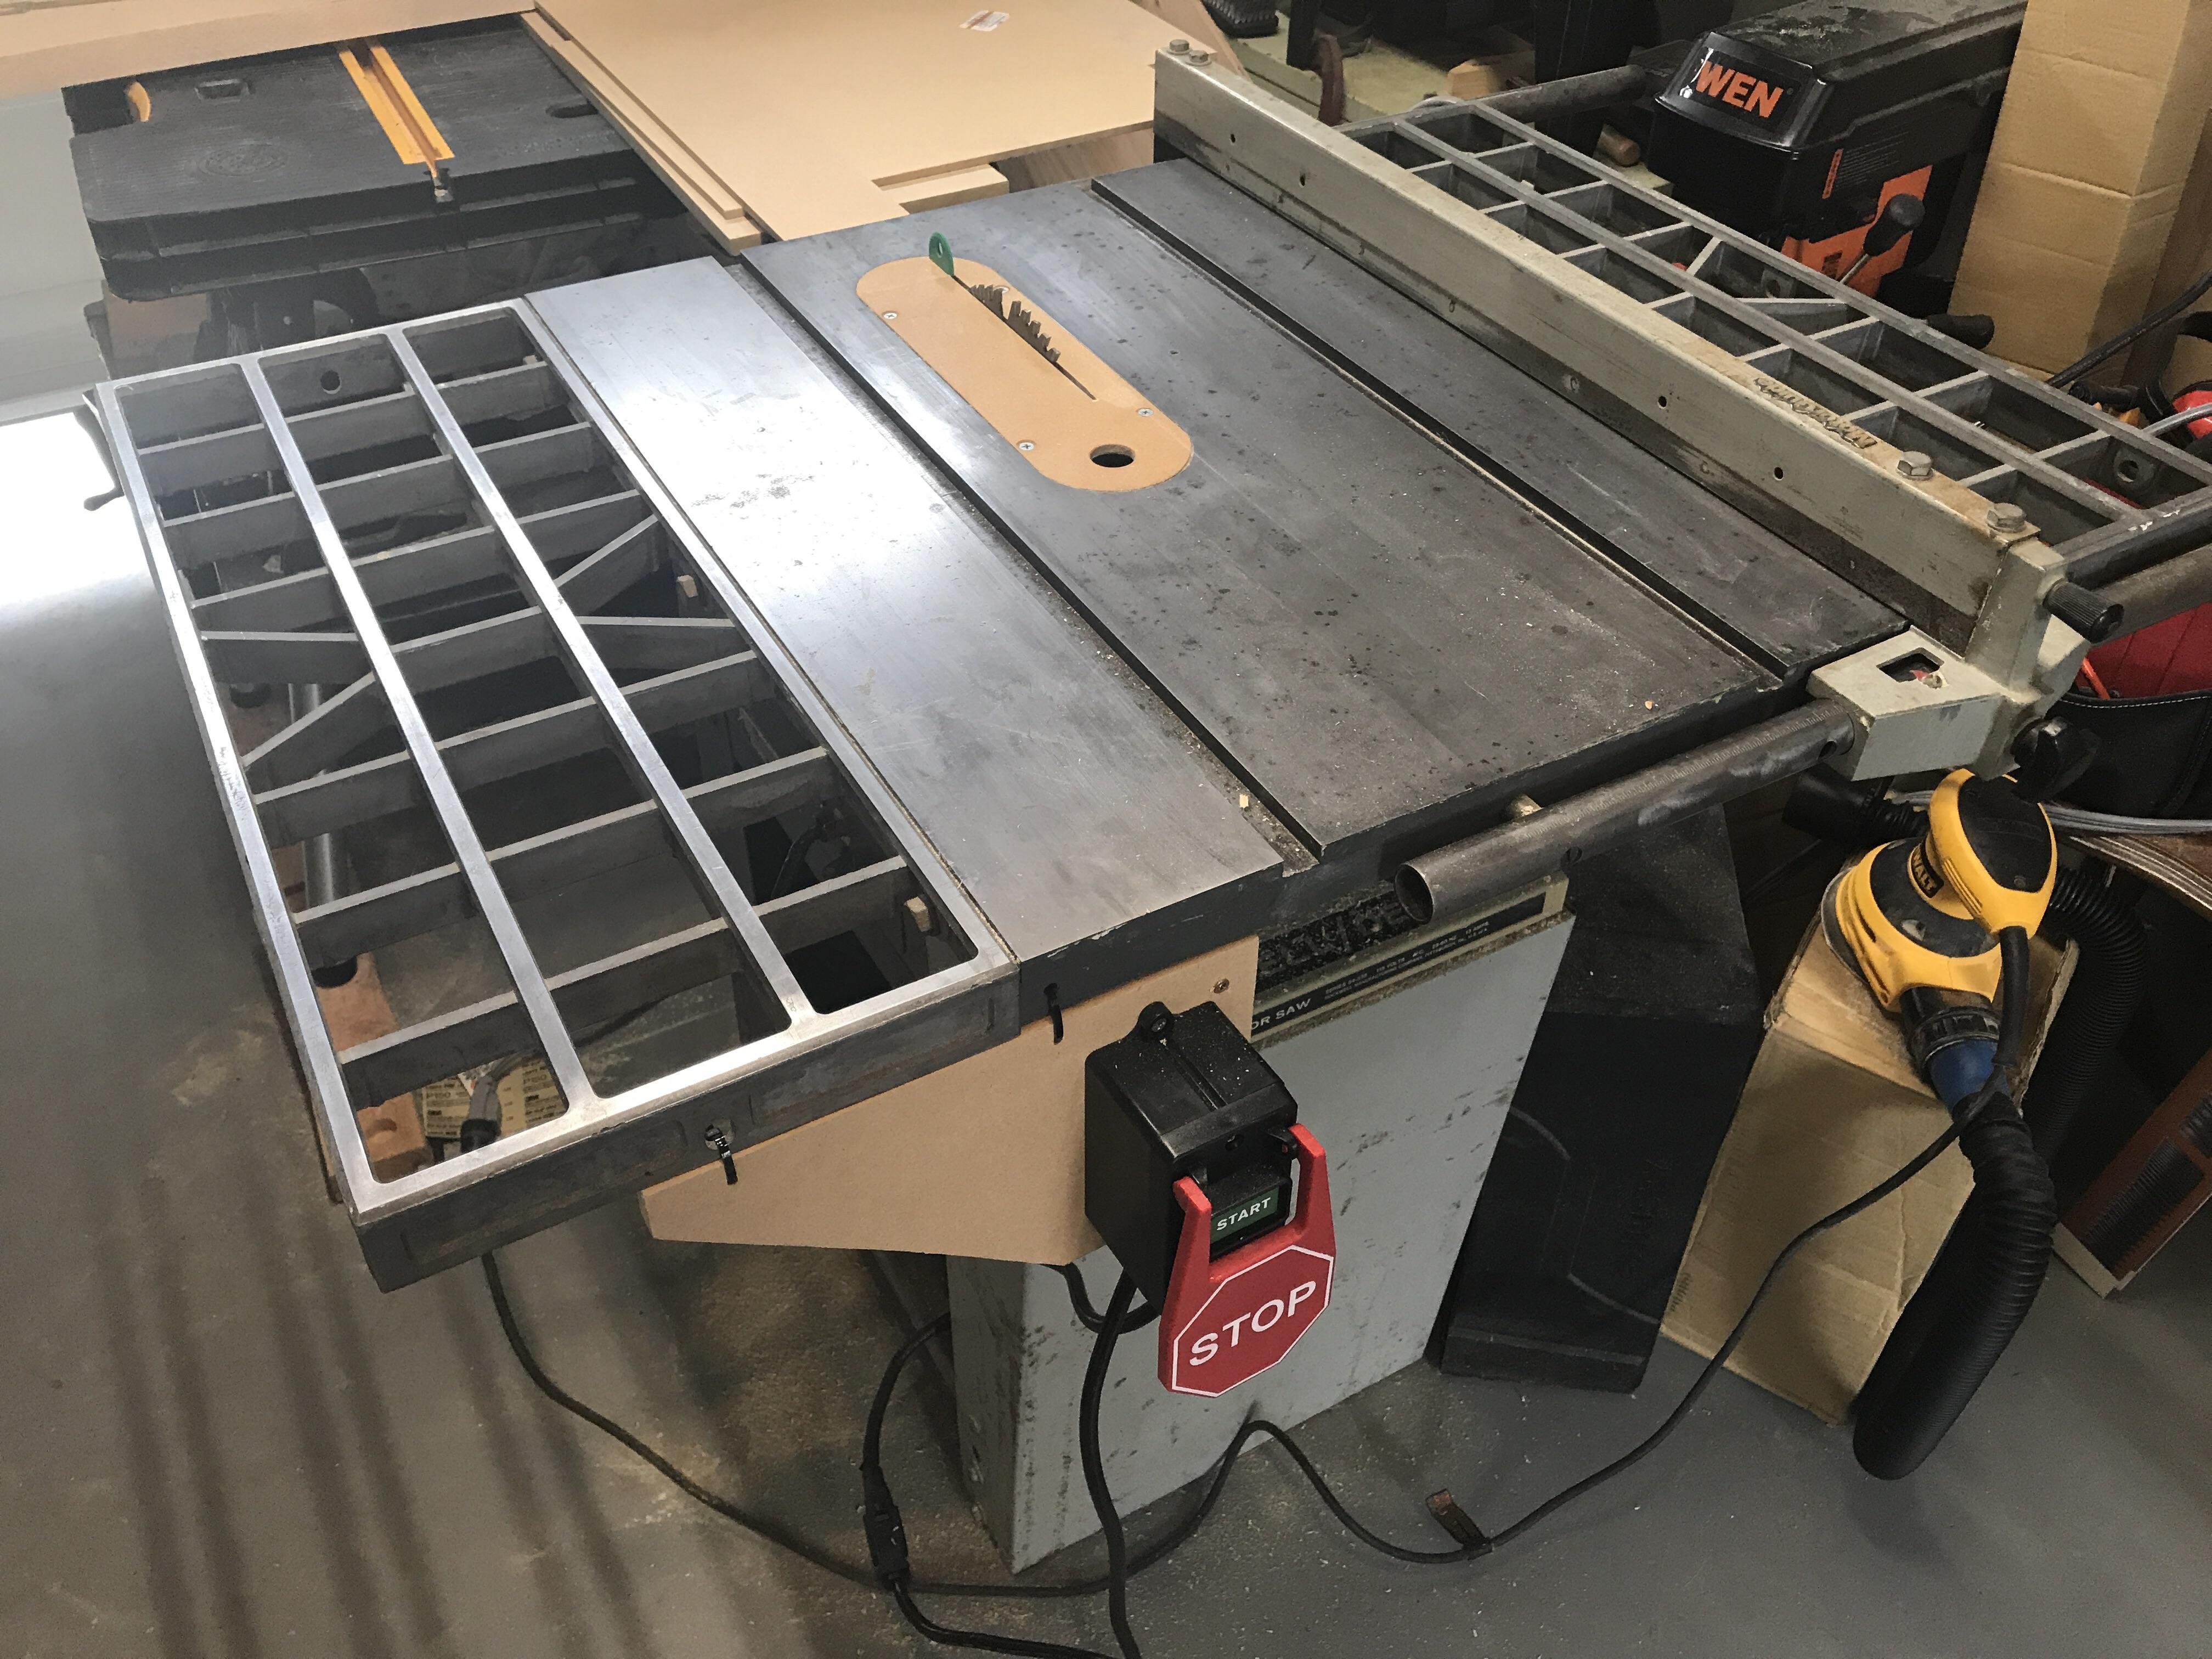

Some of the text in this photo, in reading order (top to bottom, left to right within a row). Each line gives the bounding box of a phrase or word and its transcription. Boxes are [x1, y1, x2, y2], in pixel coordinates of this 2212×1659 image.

[1696, 61, 1784, 118] WEN
[1276, 998, 1311, 1019] SAW
[1216, 1197, 1271, 1231] START
[1189, 1280, 1317, 1366] STOP
